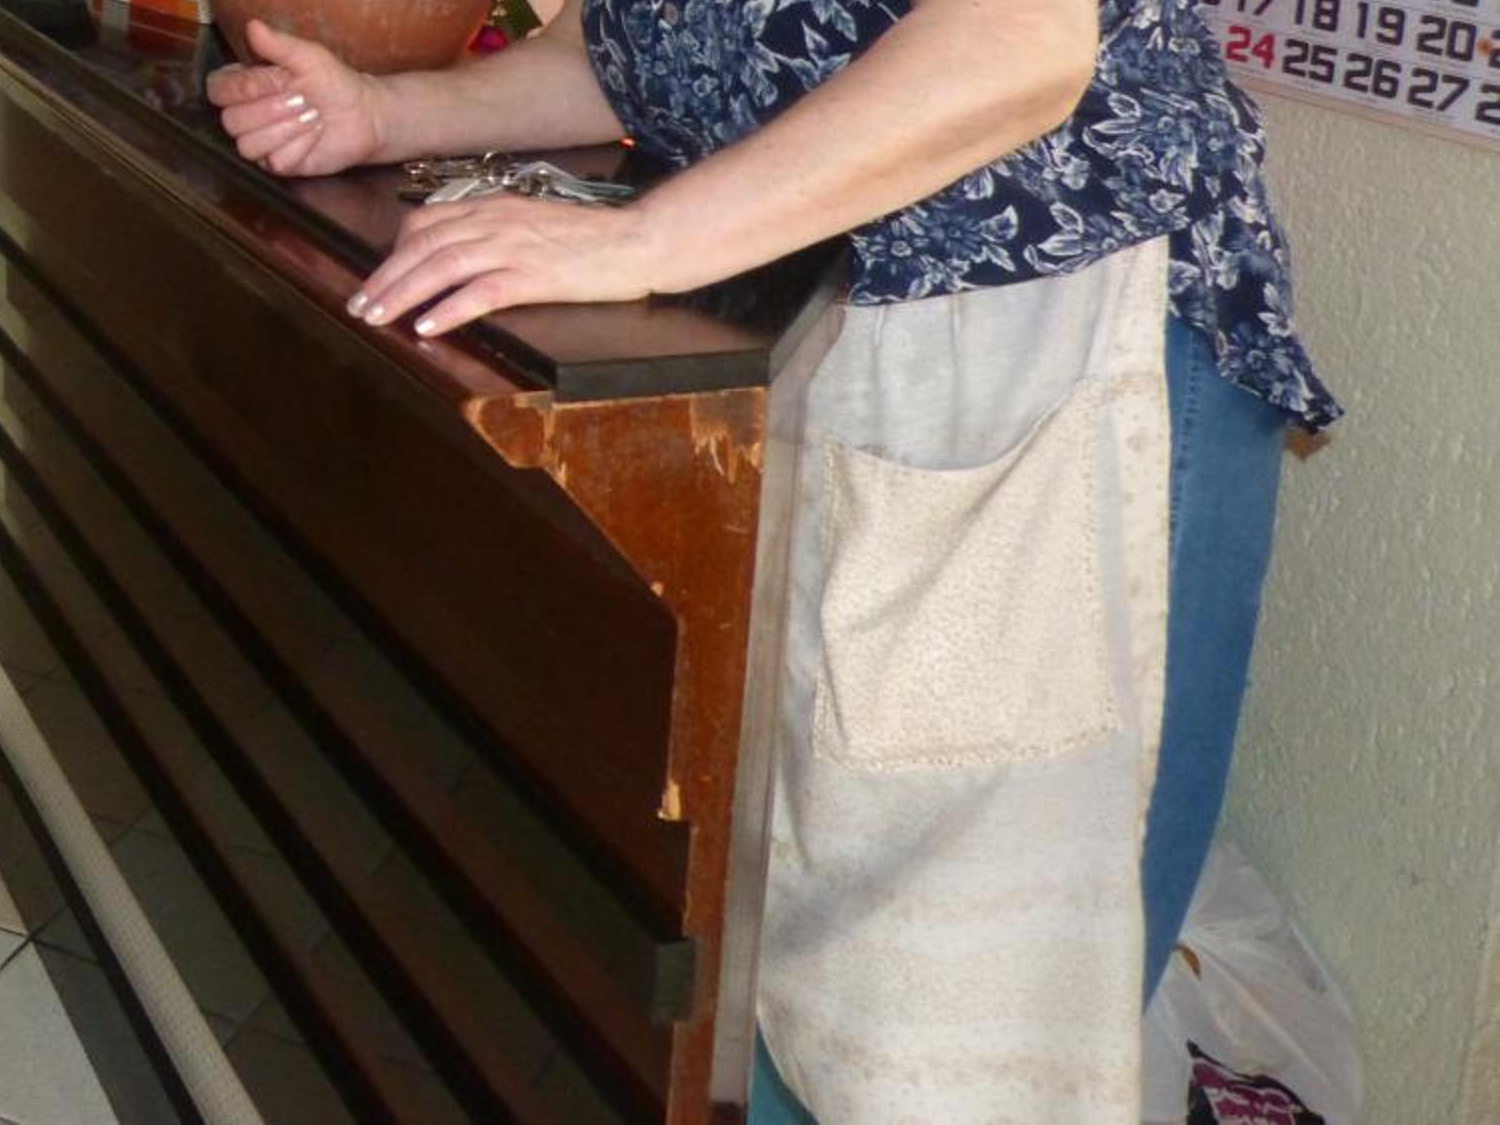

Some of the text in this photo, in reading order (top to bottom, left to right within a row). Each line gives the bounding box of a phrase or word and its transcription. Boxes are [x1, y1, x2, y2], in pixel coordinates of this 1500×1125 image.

[1357, 2, 1405, 46] 19
[1416, 14, 1477, 62] 20
[1225, 26, 1276, 69] 24
[1282, 38, 1338, 83] 25
[1343, 53, 1402, 99] 26
[1407, 67, 1470, 112] 27
